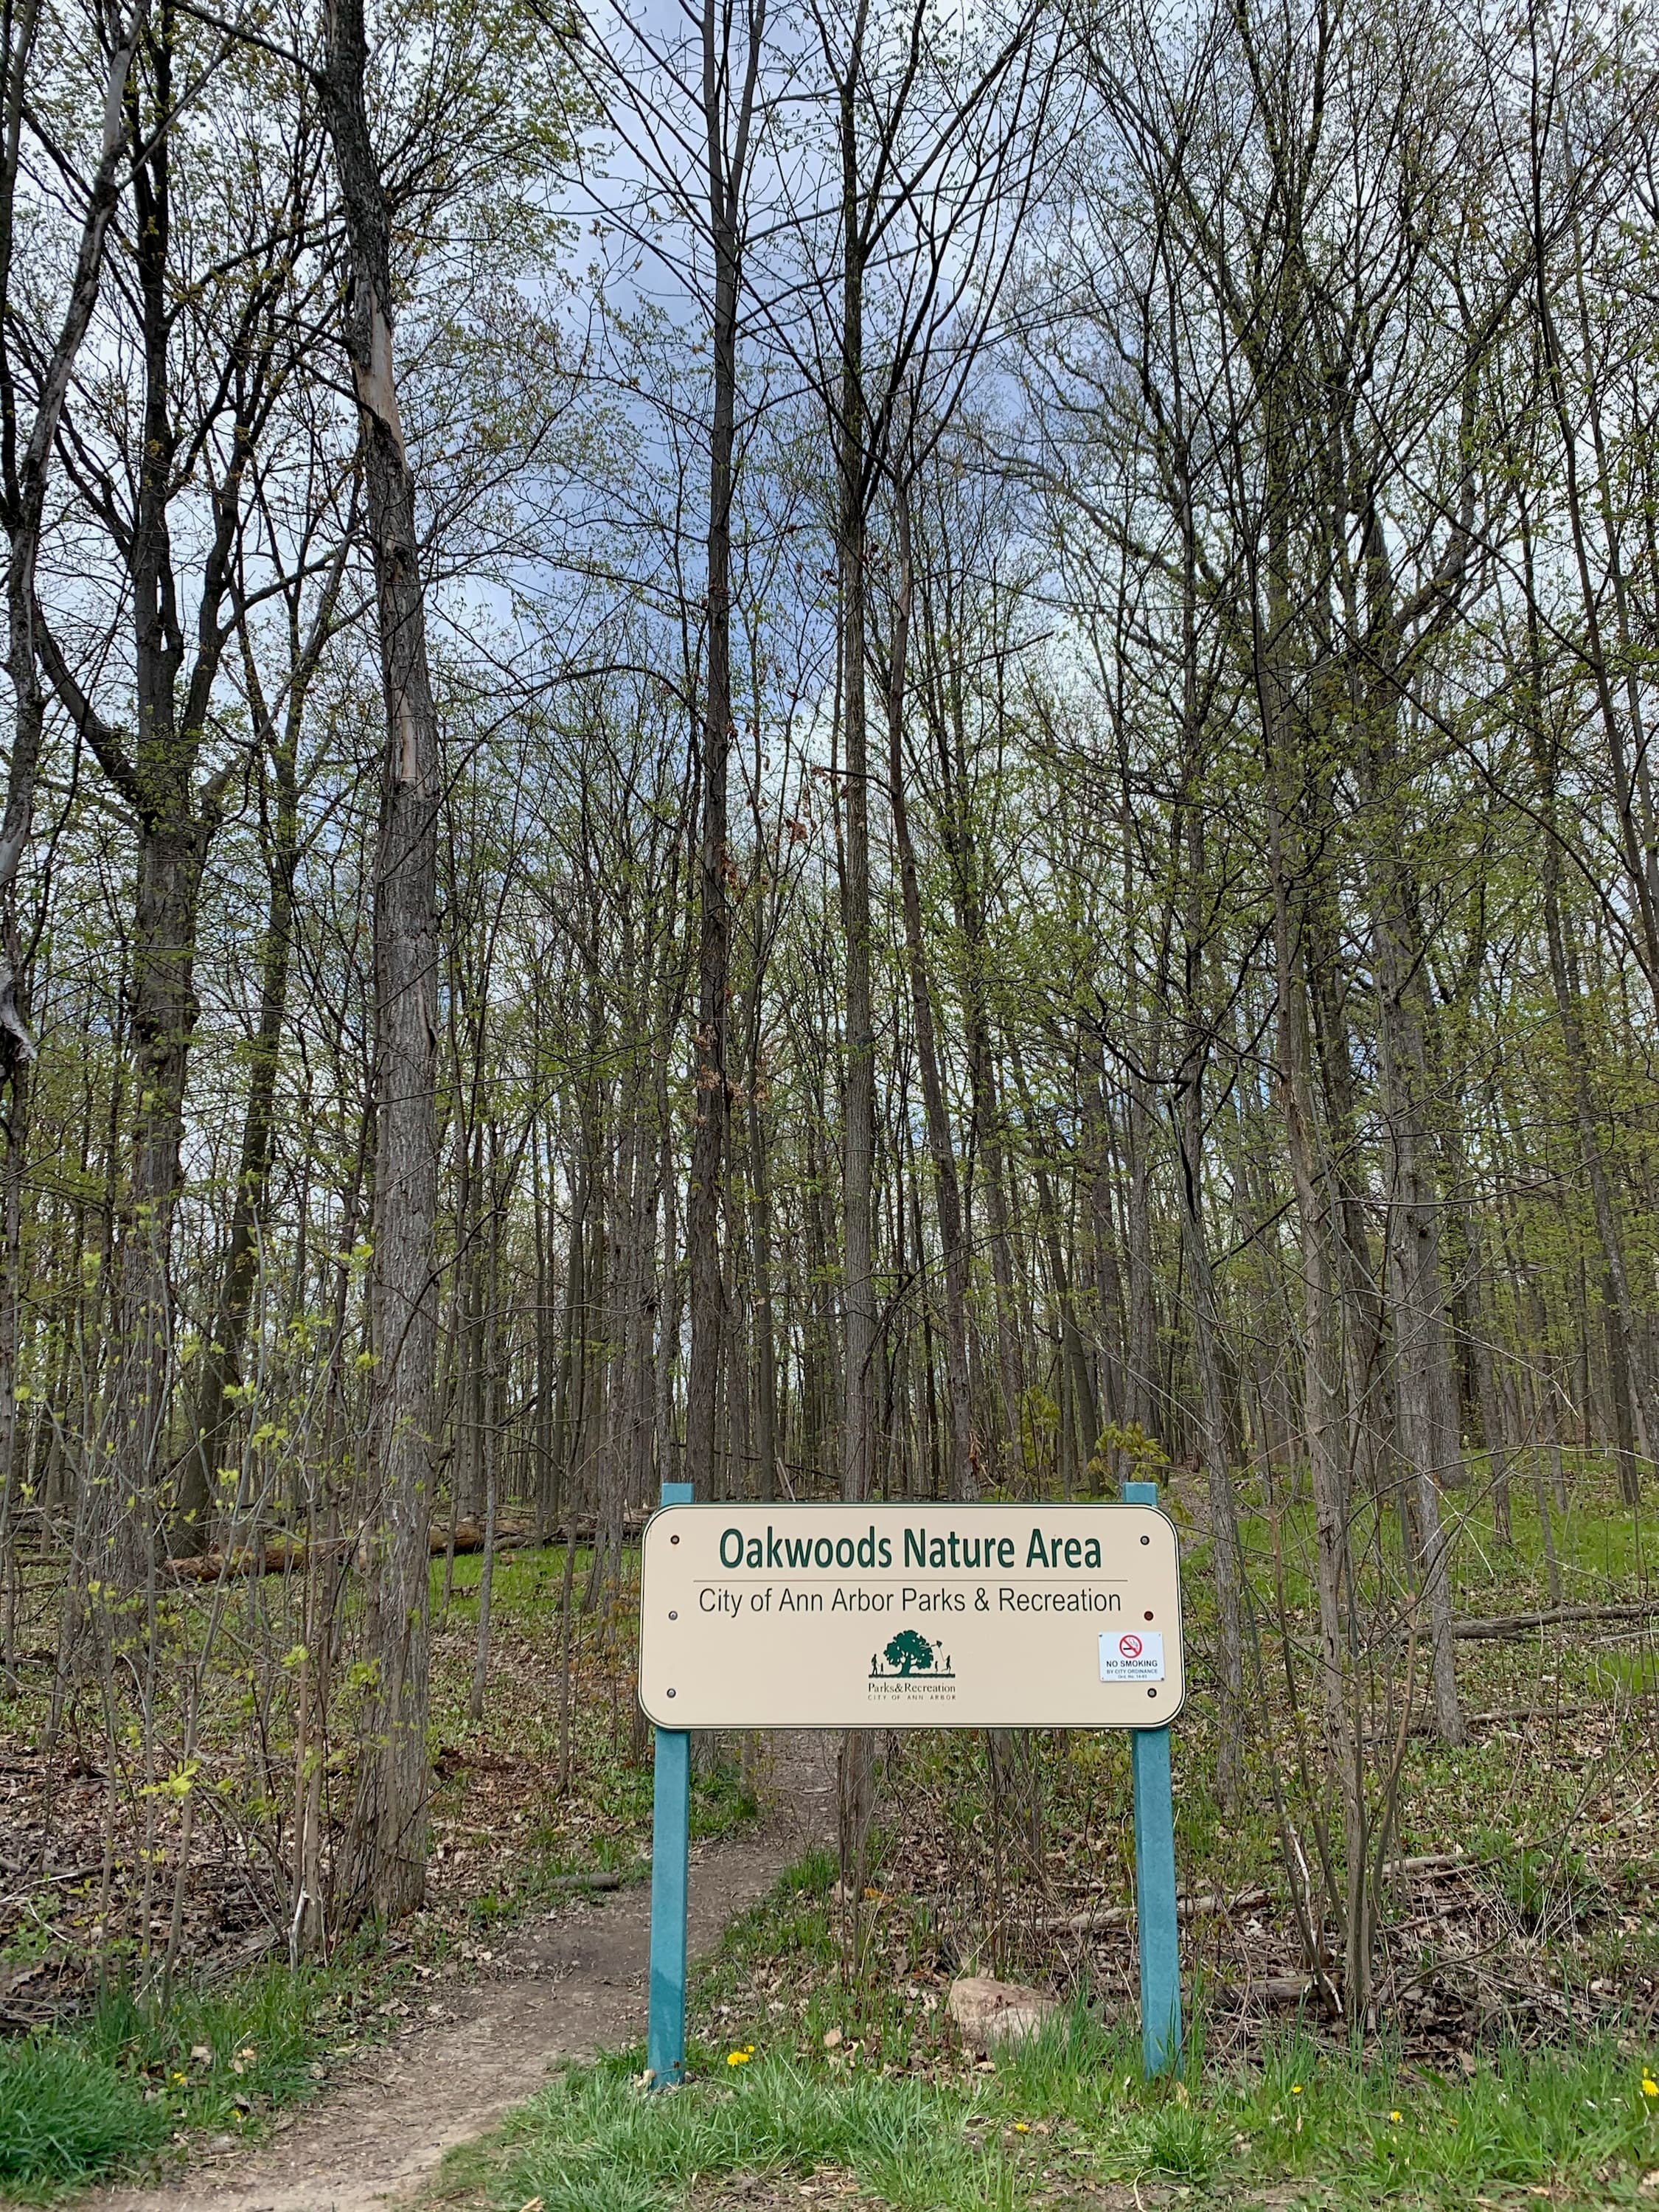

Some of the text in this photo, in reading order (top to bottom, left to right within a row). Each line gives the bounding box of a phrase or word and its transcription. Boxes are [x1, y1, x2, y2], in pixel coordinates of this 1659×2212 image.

[720, 1526, 1102, 1568] Oakwoods Nature Area
[699, 1587, 1121, 1618] City of Ann Arbor Parks & Recreation
